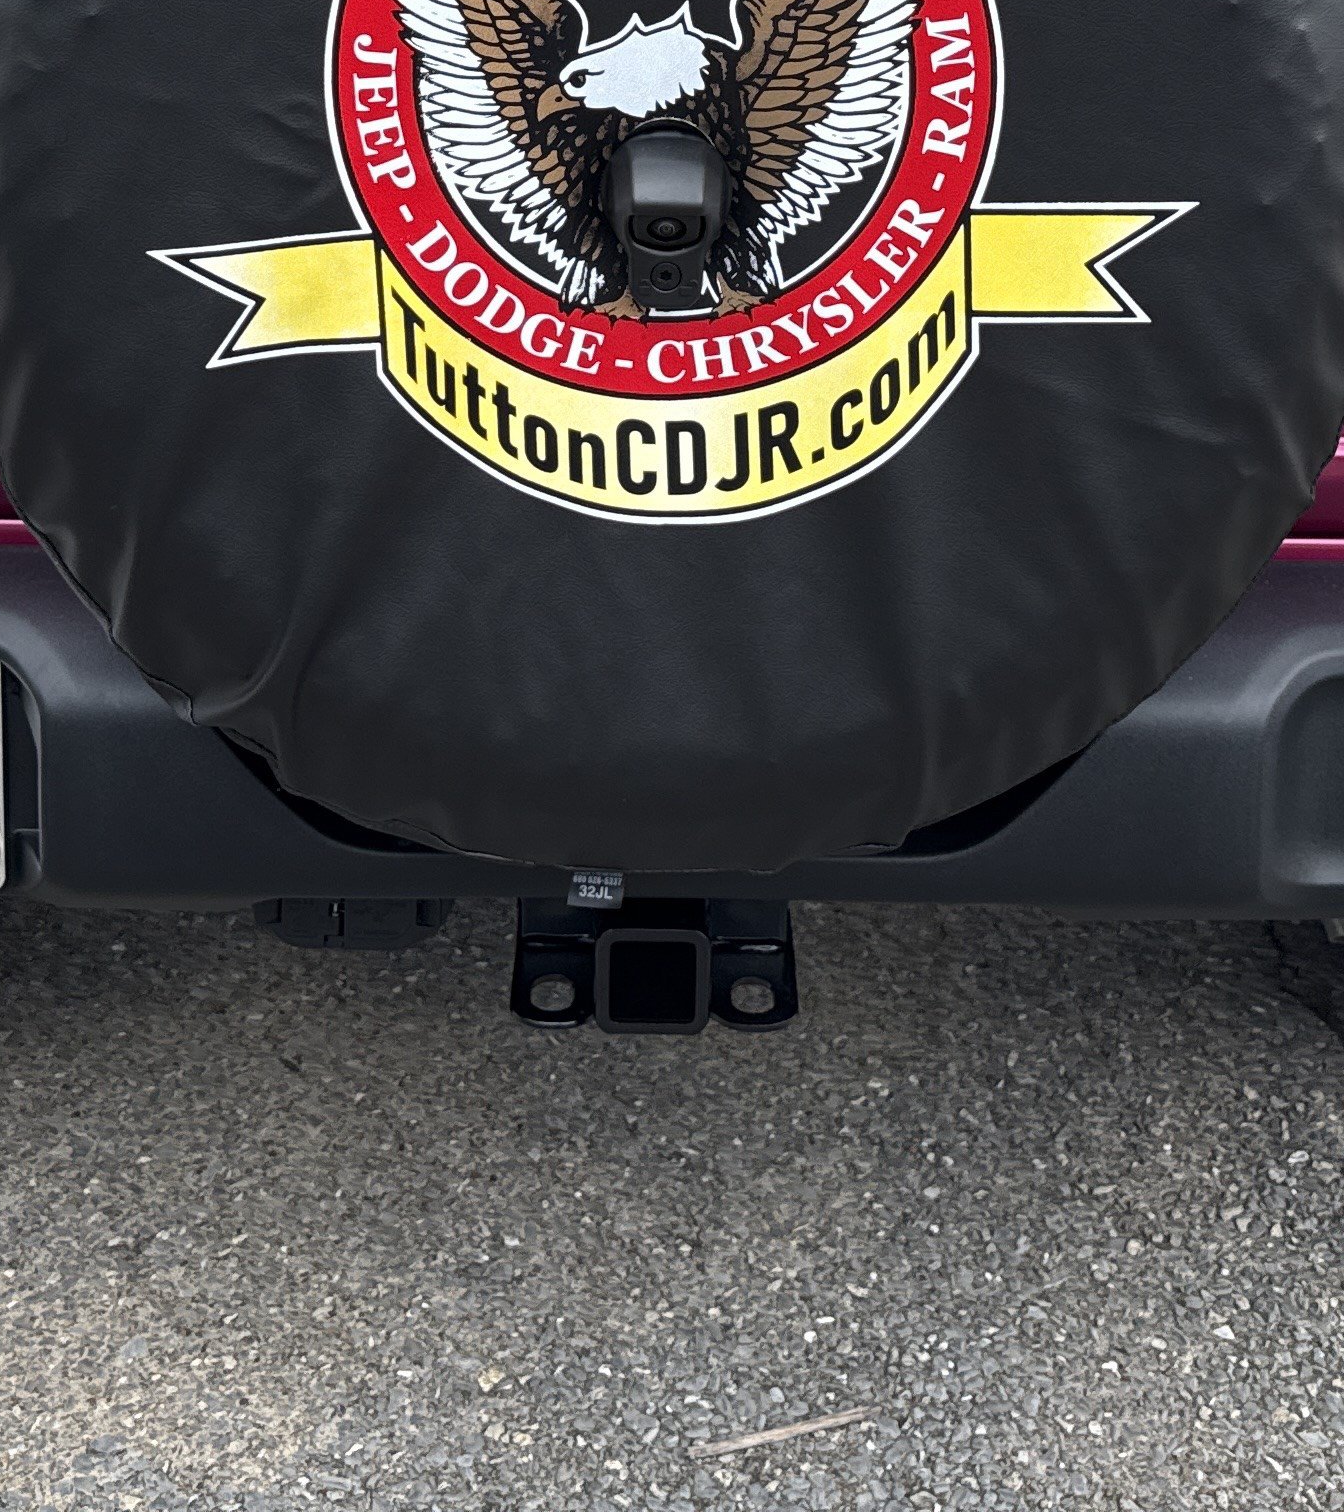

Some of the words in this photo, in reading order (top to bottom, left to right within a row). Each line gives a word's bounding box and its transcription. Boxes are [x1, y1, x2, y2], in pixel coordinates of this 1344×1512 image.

[353, 34, 418, 190] JEEP
[405, 219, 605, 376] DODGE
[646, 200, 946, 384] CHRYSLER
[921, 12, 976, 163] RAM
[391, 288, 957, 497] TuttonCDJR.com
[579, 884, 613, 899] 32JL
